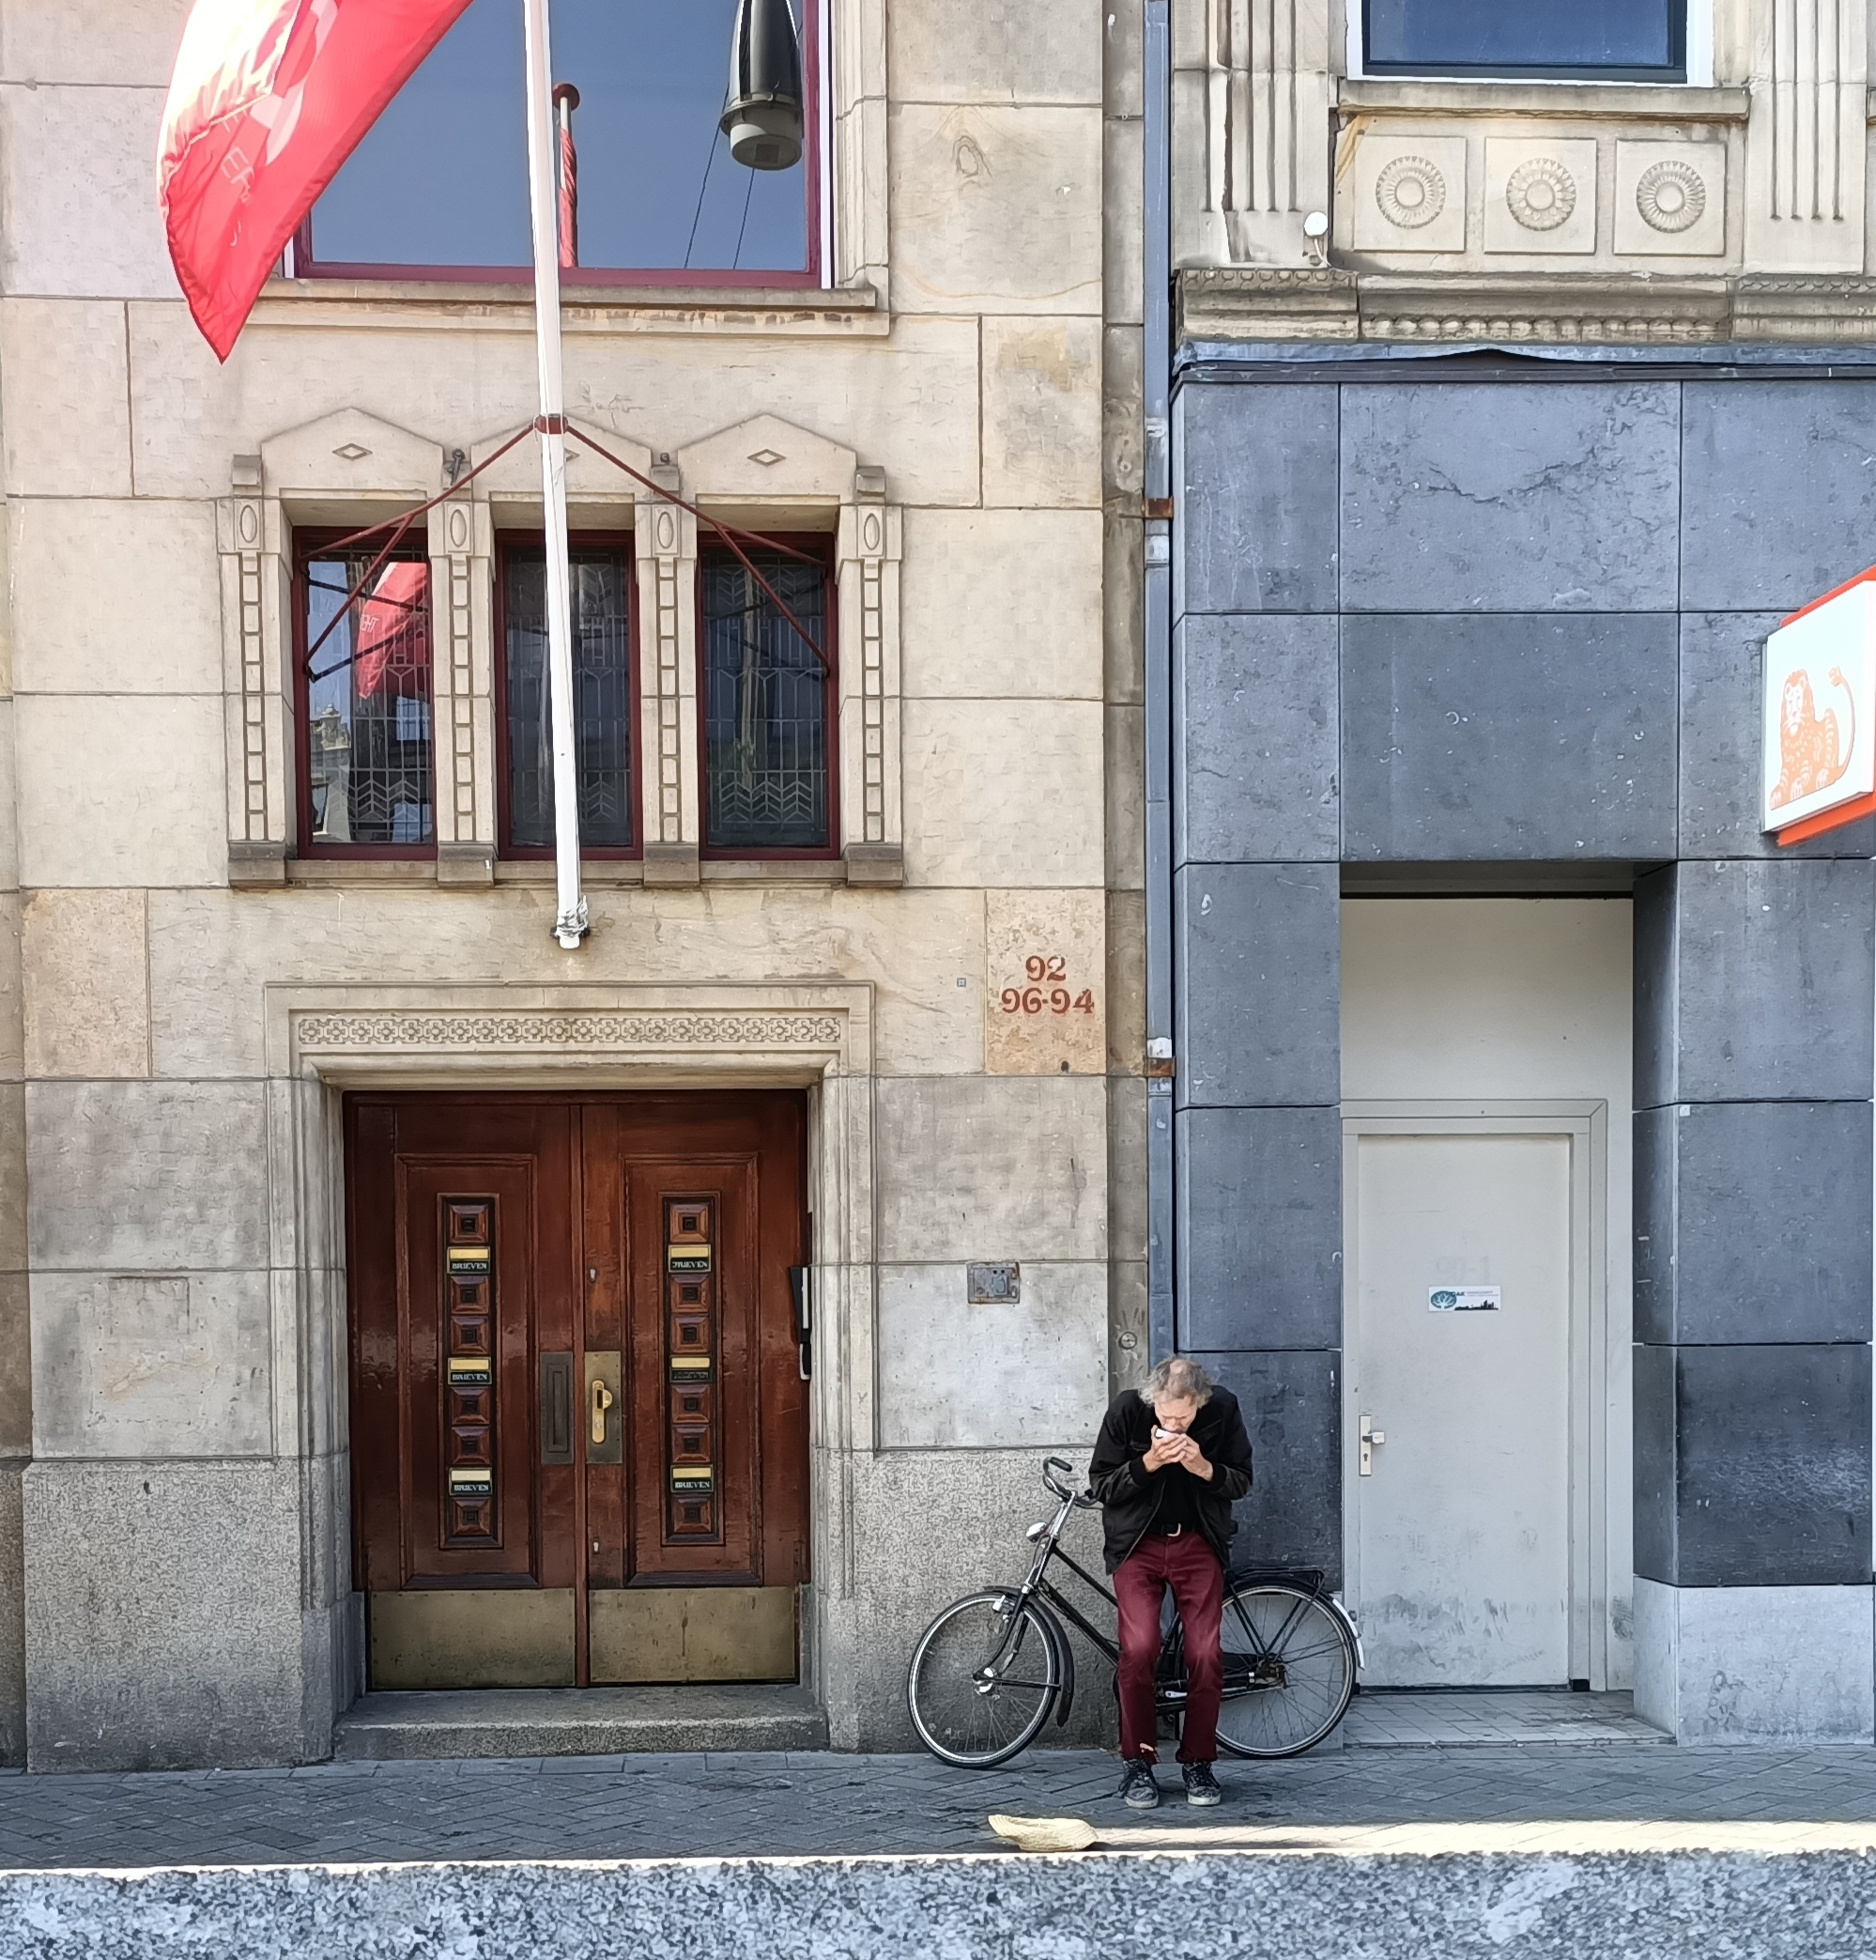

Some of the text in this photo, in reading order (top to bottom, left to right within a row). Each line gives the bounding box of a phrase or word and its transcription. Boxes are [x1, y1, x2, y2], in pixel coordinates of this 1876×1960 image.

[1025, 955, 1066, 981] 92
[1001, 987, 1095, 1014] 96-94
[452, 1261, 487, 1270] BRIEVEN
